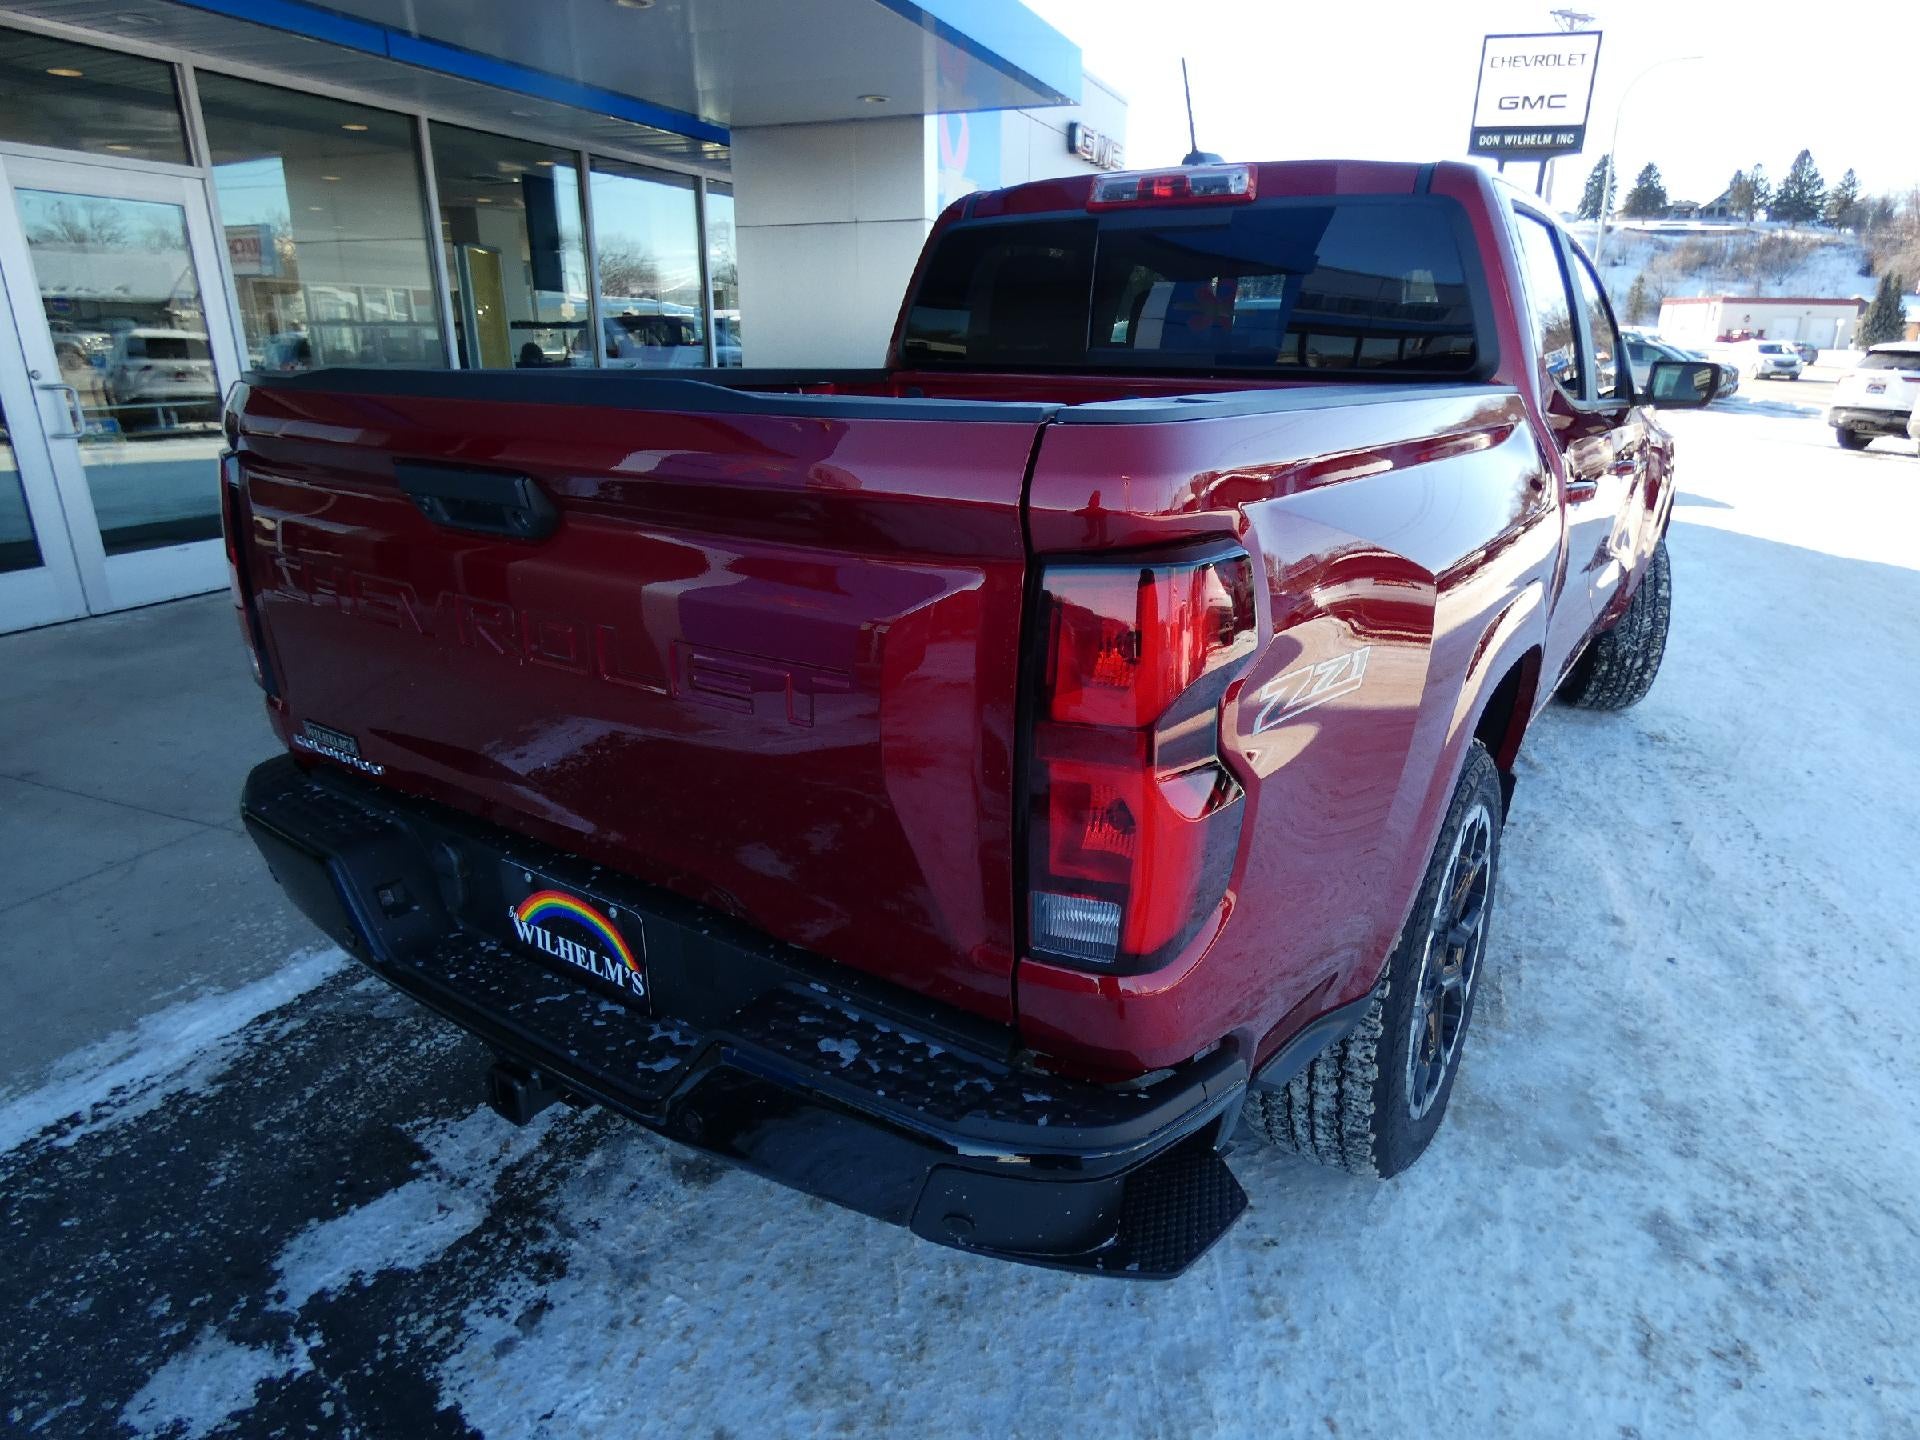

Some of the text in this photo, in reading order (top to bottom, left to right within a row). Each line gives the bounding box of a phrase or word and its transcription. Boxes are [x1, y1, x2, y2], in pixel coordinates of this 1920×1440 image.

[1490, 53, 1587, 69] CHEVROLET
[1498, 94, 1567, 110] GMC
[1069, 121, 1124, 170] GMC
[1478, 133, 1575, 146] DON WILHELM INC
[273, 557, 852, 728] CHEVROLET
[1252, 645, 1371, 737] Z71
[513, 917, 645, 996] WILHELM'S
